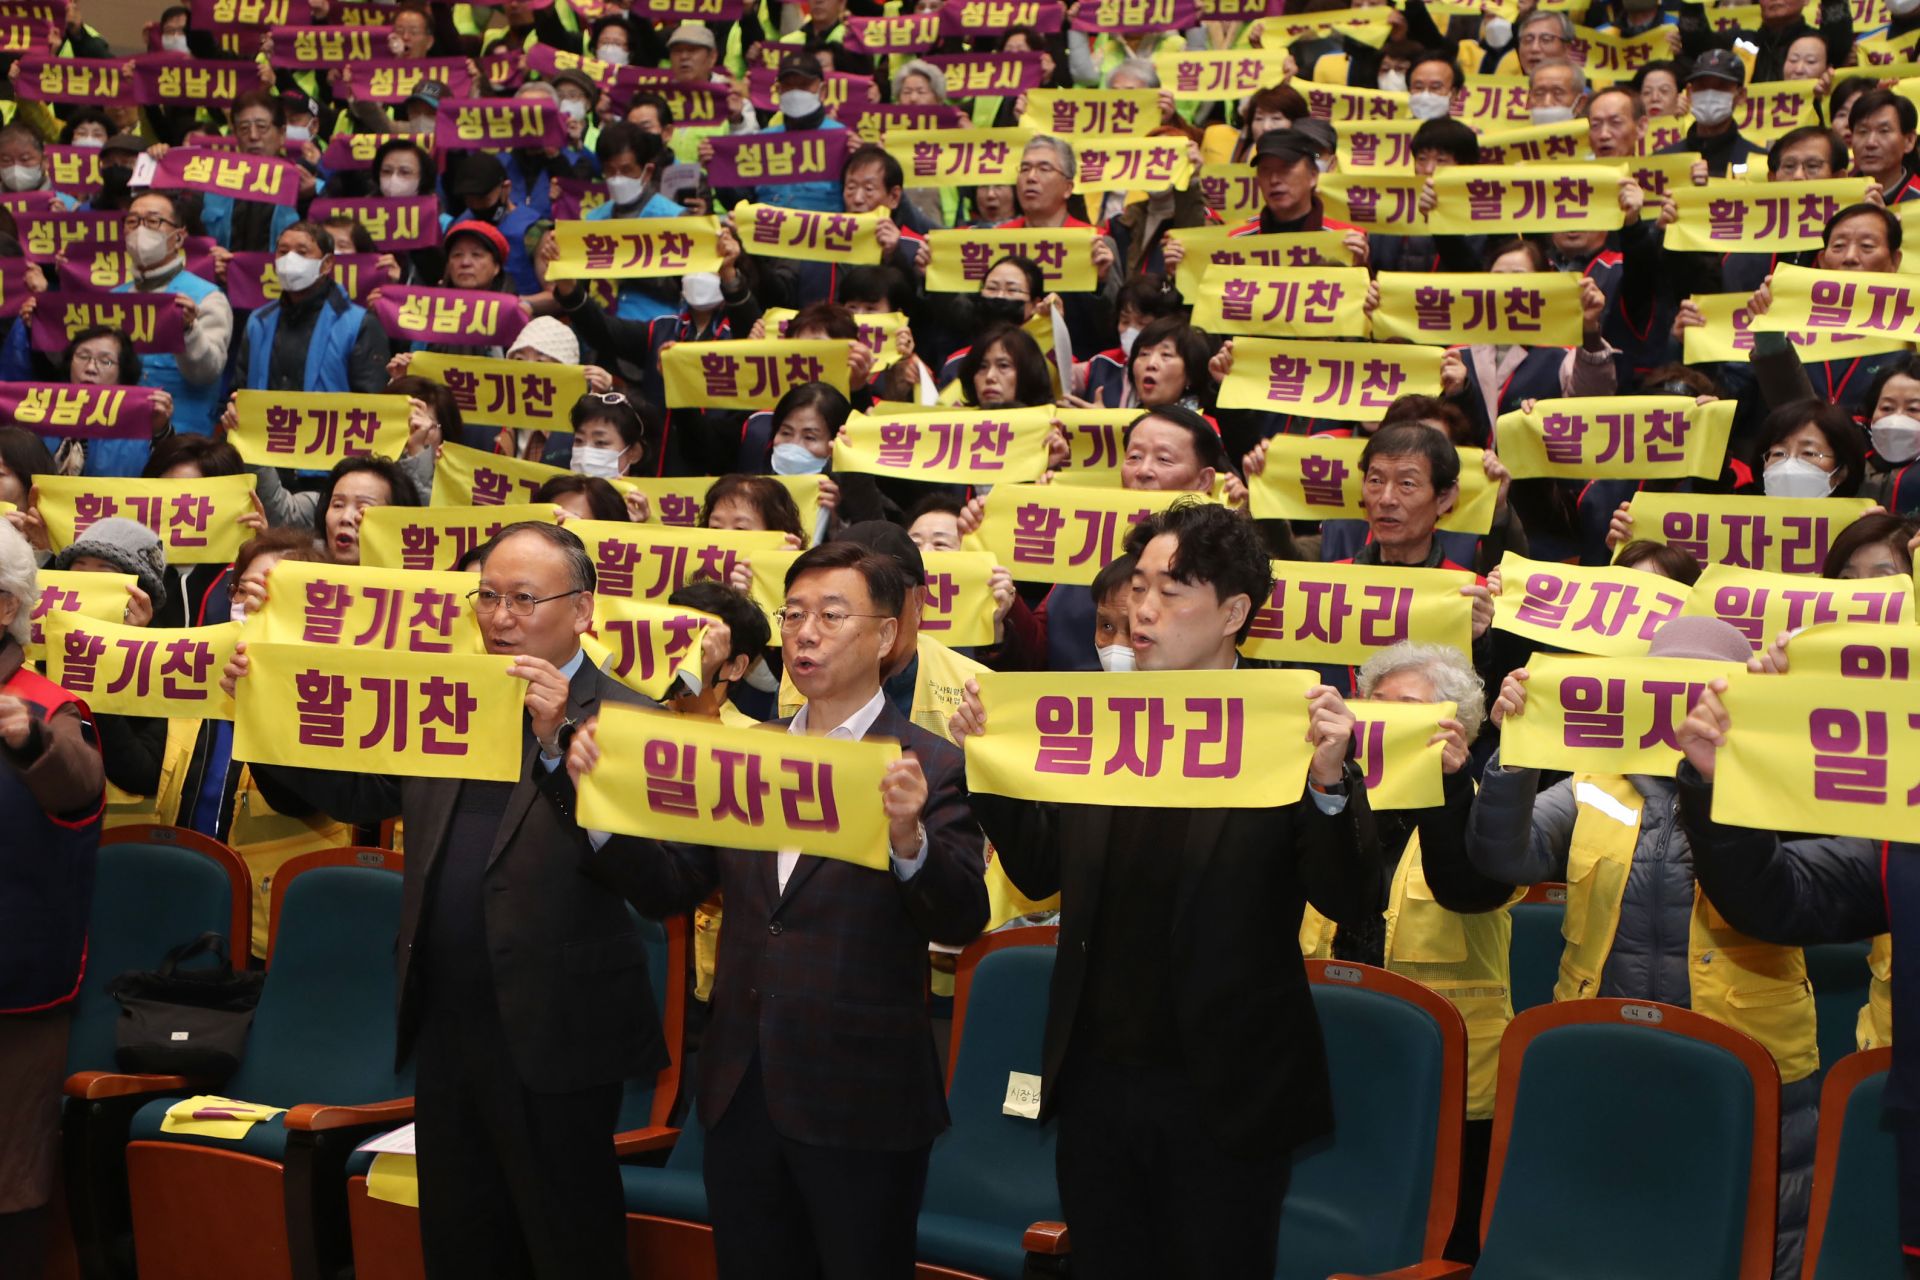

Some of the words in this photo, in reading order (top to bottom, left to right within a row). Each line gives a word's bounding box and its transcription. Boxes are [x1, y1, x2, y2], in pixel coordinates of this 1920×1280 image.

[213, 0, 288, 25] 성남시
[863, 16, 940, 46] 성남시
[961, 2, 1039, 27] 성남시
[295, 31, 372, 61] 성남시
[40, 63, 119, 97] 성남시
[158, 67, 237, 98] 성남시
[944, 61, 1022, 90] 성남시
[1177, 59, 1265, 91] 활기찬
[456, 105, 544, 139] 성남시
[1052, 98, 1140, 133] 활기찬
[1738, 92, 1804, 128] 기찬
[735, 139, 826, 177] 성남시
[913, 140, 1010, 176] 활기찬
[1079, 147, 1178, 183] 활기찬
[1350, 131, 1411, 166] 활기
[183, 155, 283, 195] 성남시
[1201, 176, 1260, 211] 활기
[1346, 185, 1416, 224] 활기
[1466, 177, 1594, 221] 활기찬
[1709, 193, 1840, 241] 활기찬
[582, 230, 694, 269] 활기찬
[753, 207, 859, 252] 활기찬
[398, 294, 500, 336] 성남시
[1221, 278, 1344, 323] 활기찬
[1415, 285, 1546, 332] 활기찬
[1807, 280, 1920, 335] 일자
[443, 367, 557, 418] 활기찬
[1266, 354, 1406, 408] 활기찬
[13, 387, 126, 427] 성남시
[266, 405, 381, 456] 활기찬
[875, 420, 1015, 470] 활기찬
[1542, 409, 1691, 465] 활기찬
[401, 522, 502, 571] 활기
[1013, 503, 1150, 568] 활기
[1663, 512, 1829, 574] 일자리
[303, 579, 461, 653] 활기찬
[61, 629, 215, 699] 활기찬
[295, 669, 477, 756] 활기찬
[1560, 676, 1707, 751] 일자
[1035, 695, 1245, 779] 일자리
[643, 738, 840, 833] 일자리
